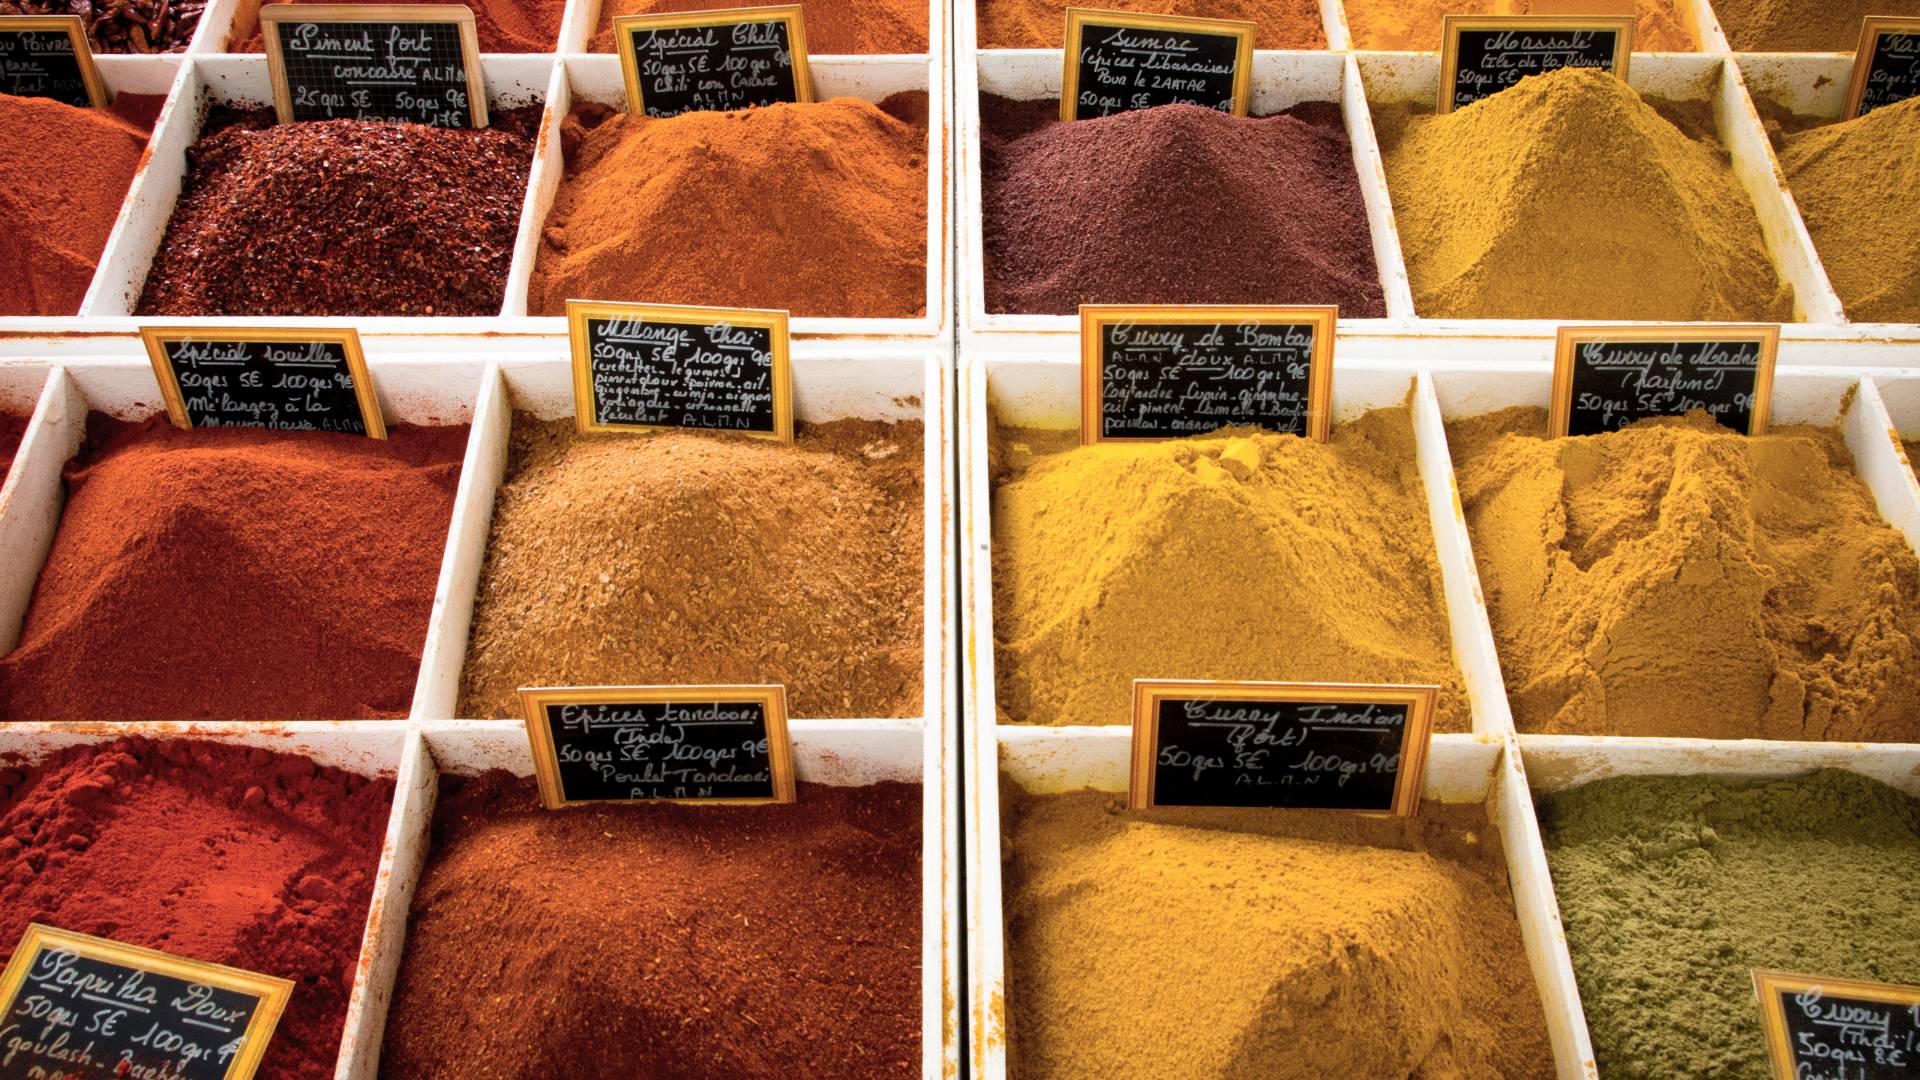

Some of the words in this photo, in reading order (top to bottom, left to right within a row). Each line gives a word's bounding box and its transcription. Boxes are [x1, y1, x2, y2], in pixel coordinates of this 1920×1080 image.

[291, 24, 374, 51] Piment
[638, 27, 719, 59] Spécial
[731, 22, 785, 45] Chili
[1101, 29, 1198, 51] Sumac
[689, 56, 710, 73] 5€
[1518, 54, 1537, 68] de
[1542, 52, 1562, 68] la
[655, 77, 690, 93] Chili
[699, 80, 724, 90] con
[1134, 69, 1145, 87] le
[1497, 68, 1519, 85] 5€
[446, 90, 467, 108] 9€
[1131, 92, 1150, 109] 5€
[598, 316, 696, 353] Mélange
[1111, 316, 1187, 354] Curry
[1194, 323, 1224, 346] de
[1236, 319, 1315, 357] Bombay
[172, 338, 252, 368] Spécial
[1178, 350, 1233, 365] doux
[1583, 340, 1656, 374] Curry
[1660, 343, 1682, 364] de
[240, 371, 263, 388] 5€
[1160, 366, 1182, 380] 5€
[306, 394, 330, 412] la
[1637, 394, 1663, 411] 5€
[562, 705, 646, 733] Epices
[1185, 696, 1280, 733] Curry
[1297, 704, 1403, 725] Indian
[614, 725, 685, 745] (Inde)
[621, 744, 649, 760] 5€
[742, 739, 769, 758] 9€
[1233, 750, 1269, 769] 5€
[1370, 753, 1401, 773] 9€
[29, 948, 157, 1004] Paprika
[171, 982, 246, 1022] Doux
[86, 1009, 127, 1036] 5€
[1796, 985, 1890, 1042] Curry
